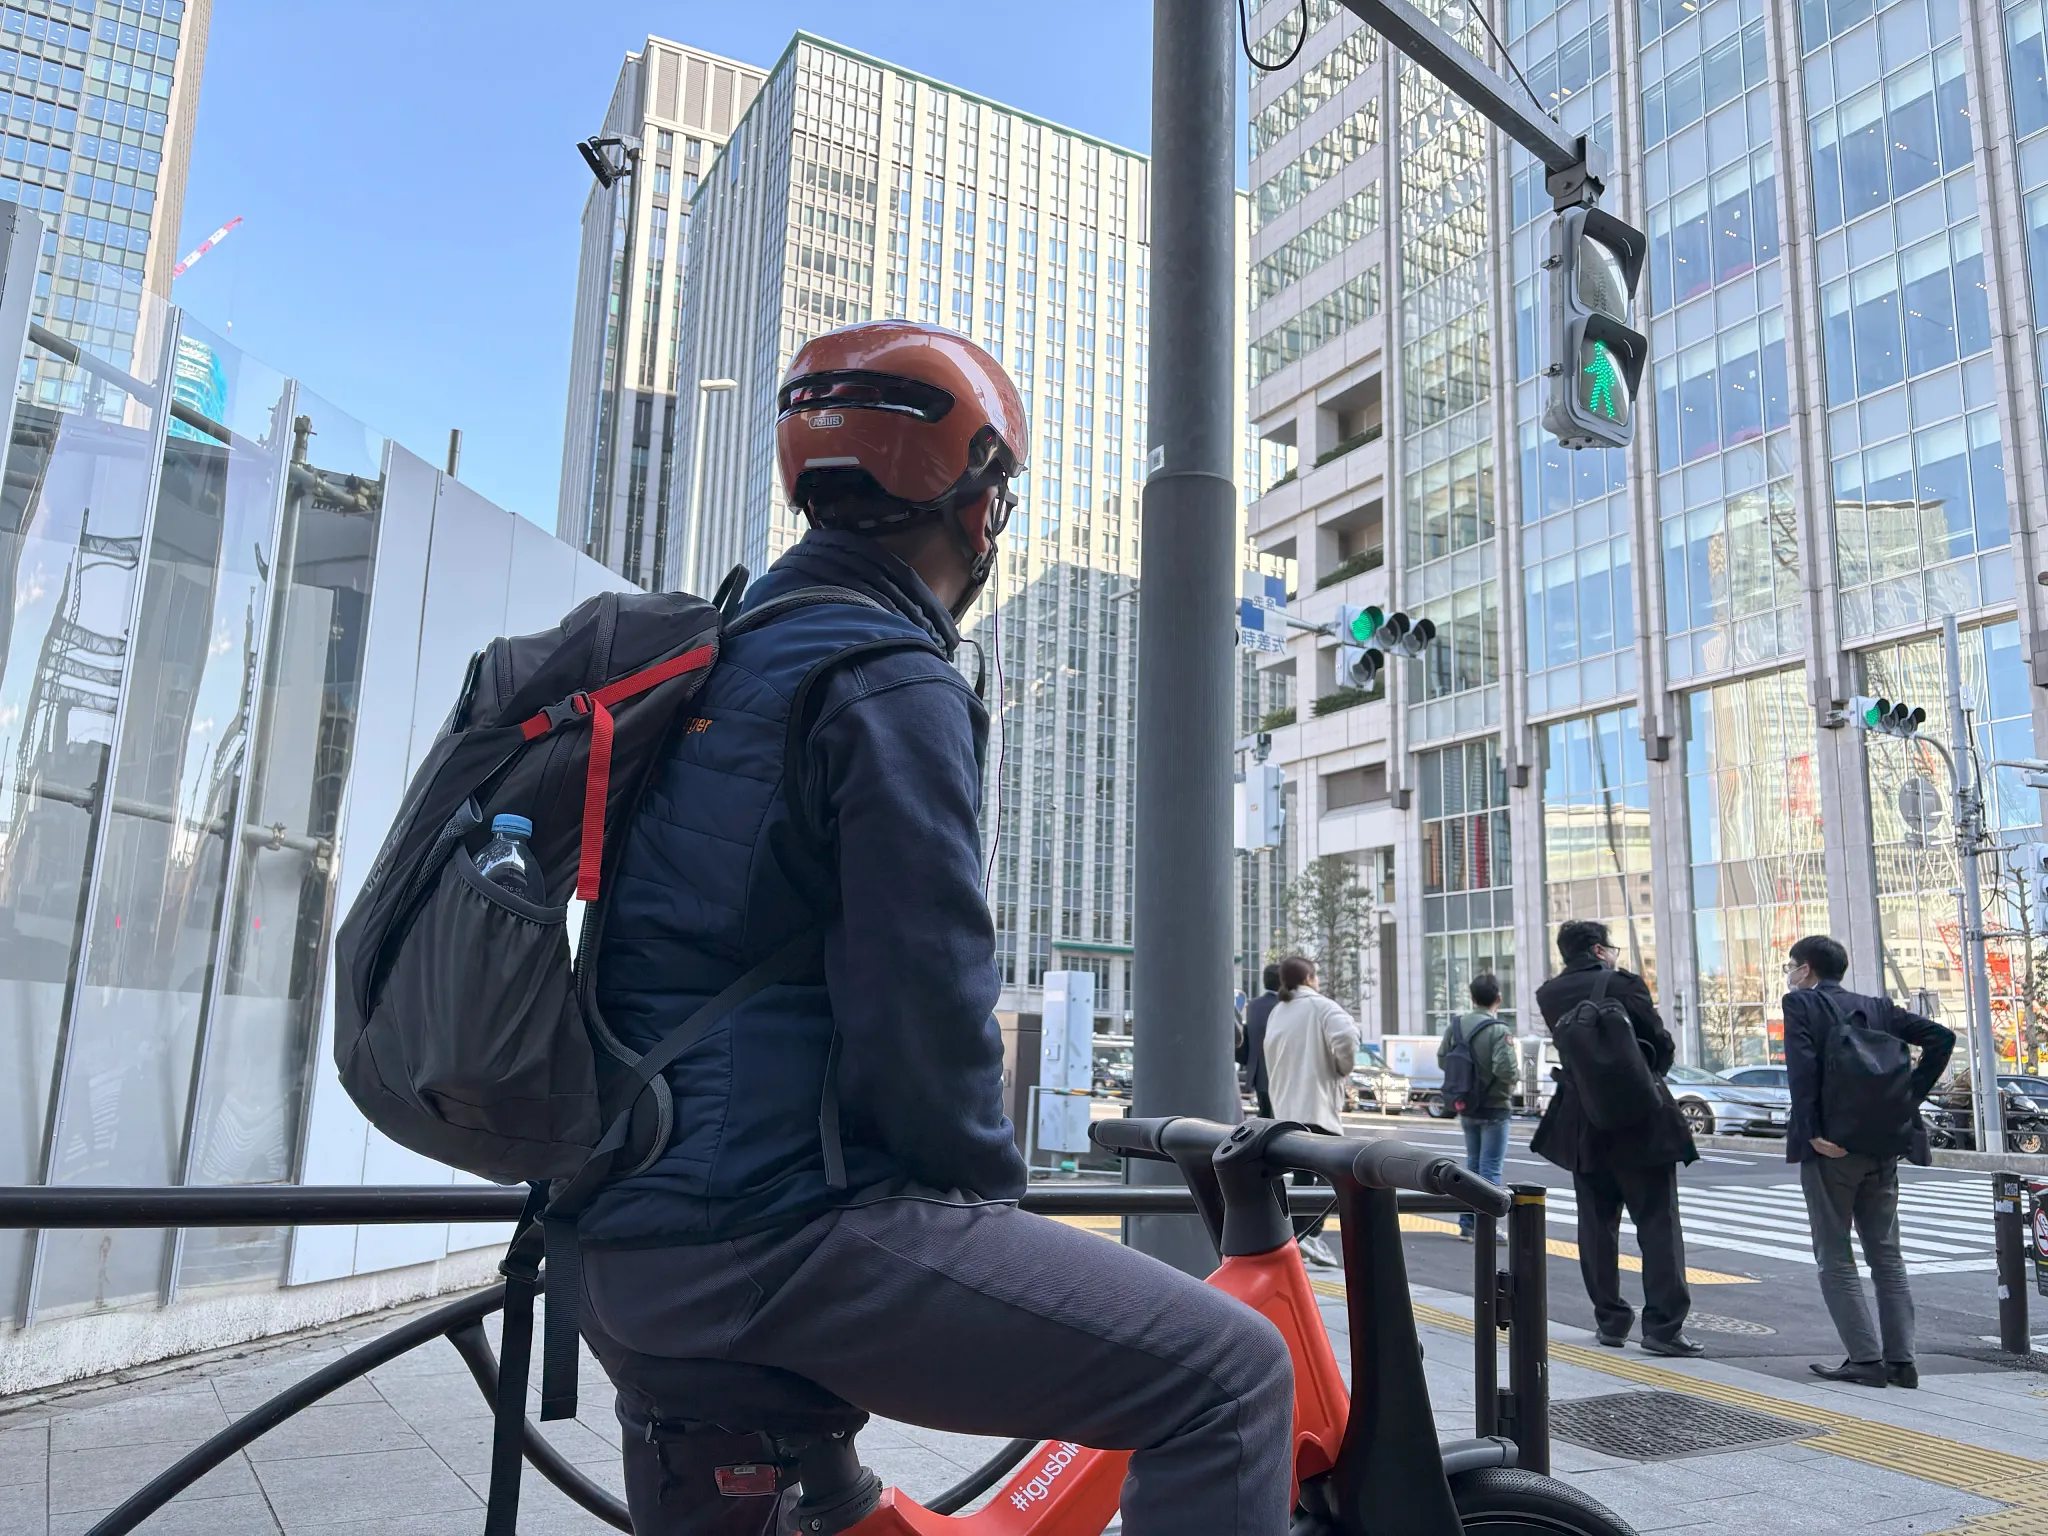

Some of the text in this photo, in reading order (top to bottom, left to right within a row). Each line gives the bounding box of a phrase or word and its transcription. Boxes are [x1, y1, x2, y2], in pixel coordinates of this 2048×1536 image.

[812, 416, 840, 427] ABUS
[1241, 630, 1286, 656] 時差式
